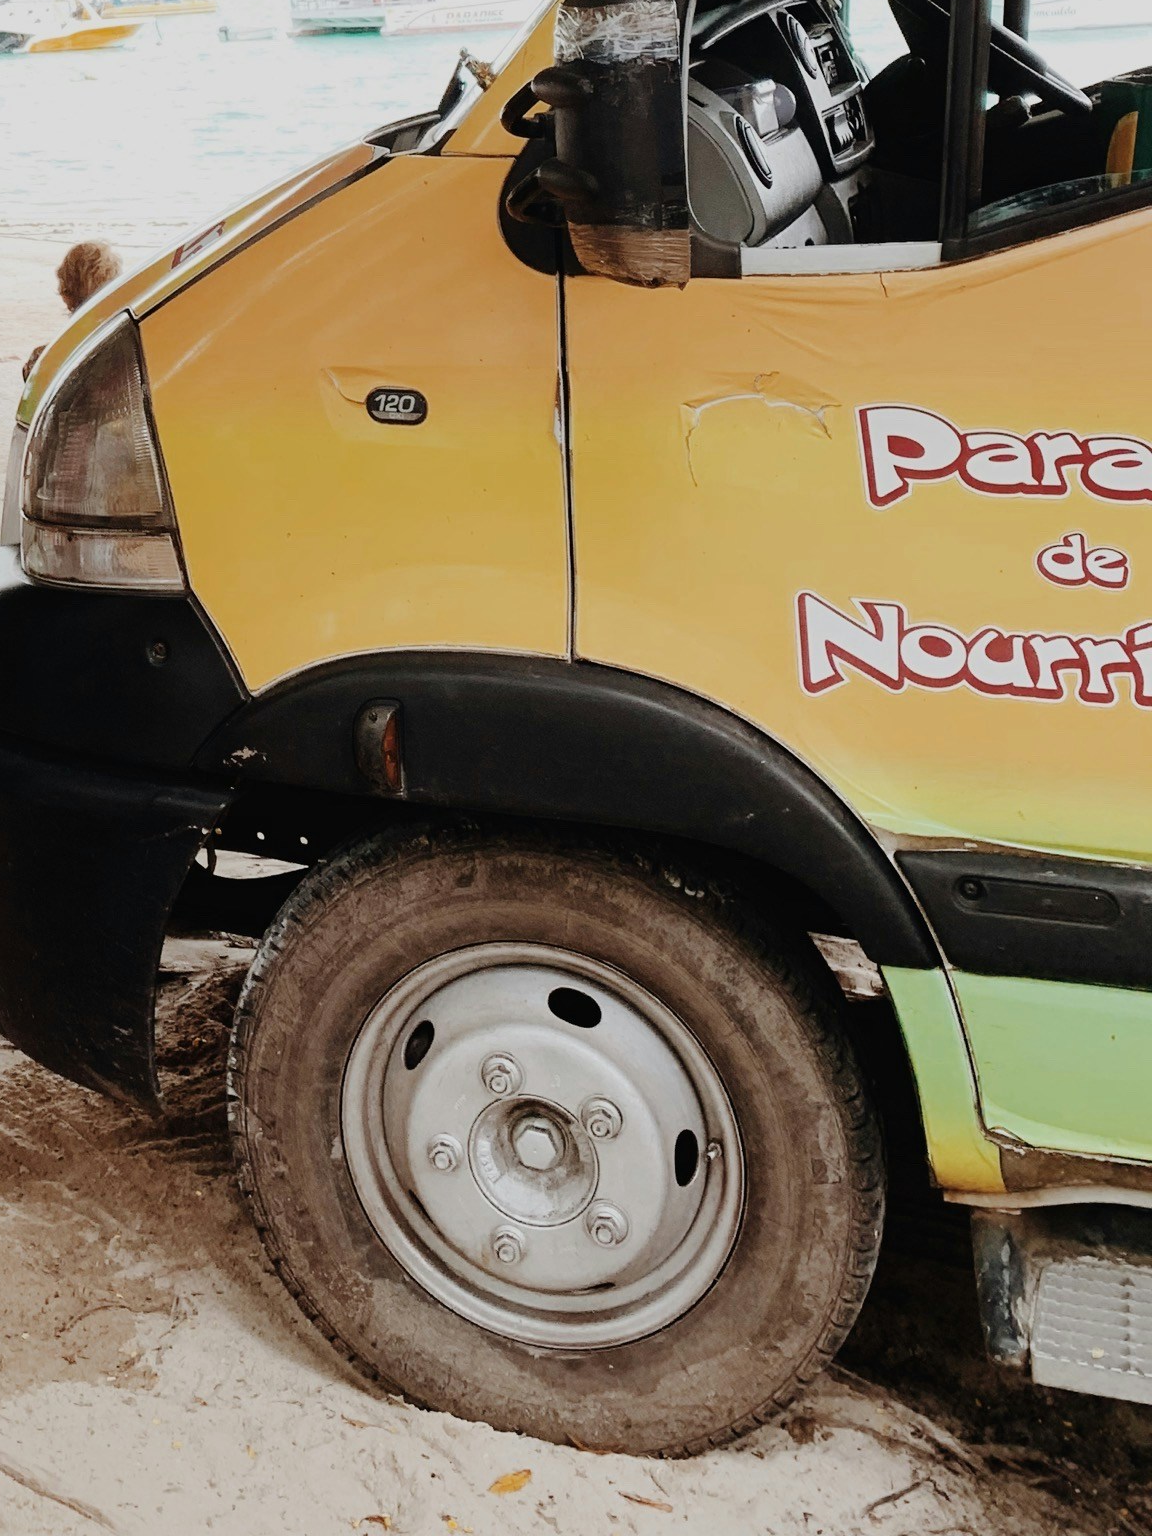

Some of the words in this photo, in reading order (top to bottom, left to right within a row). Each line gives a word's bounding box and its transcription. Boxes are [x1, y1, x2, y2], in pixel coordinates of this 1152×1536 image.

[374, 394, 416, 413] 120
[856, 405, 1152, 509] Para
[1037, 533, 1128, 588] de
